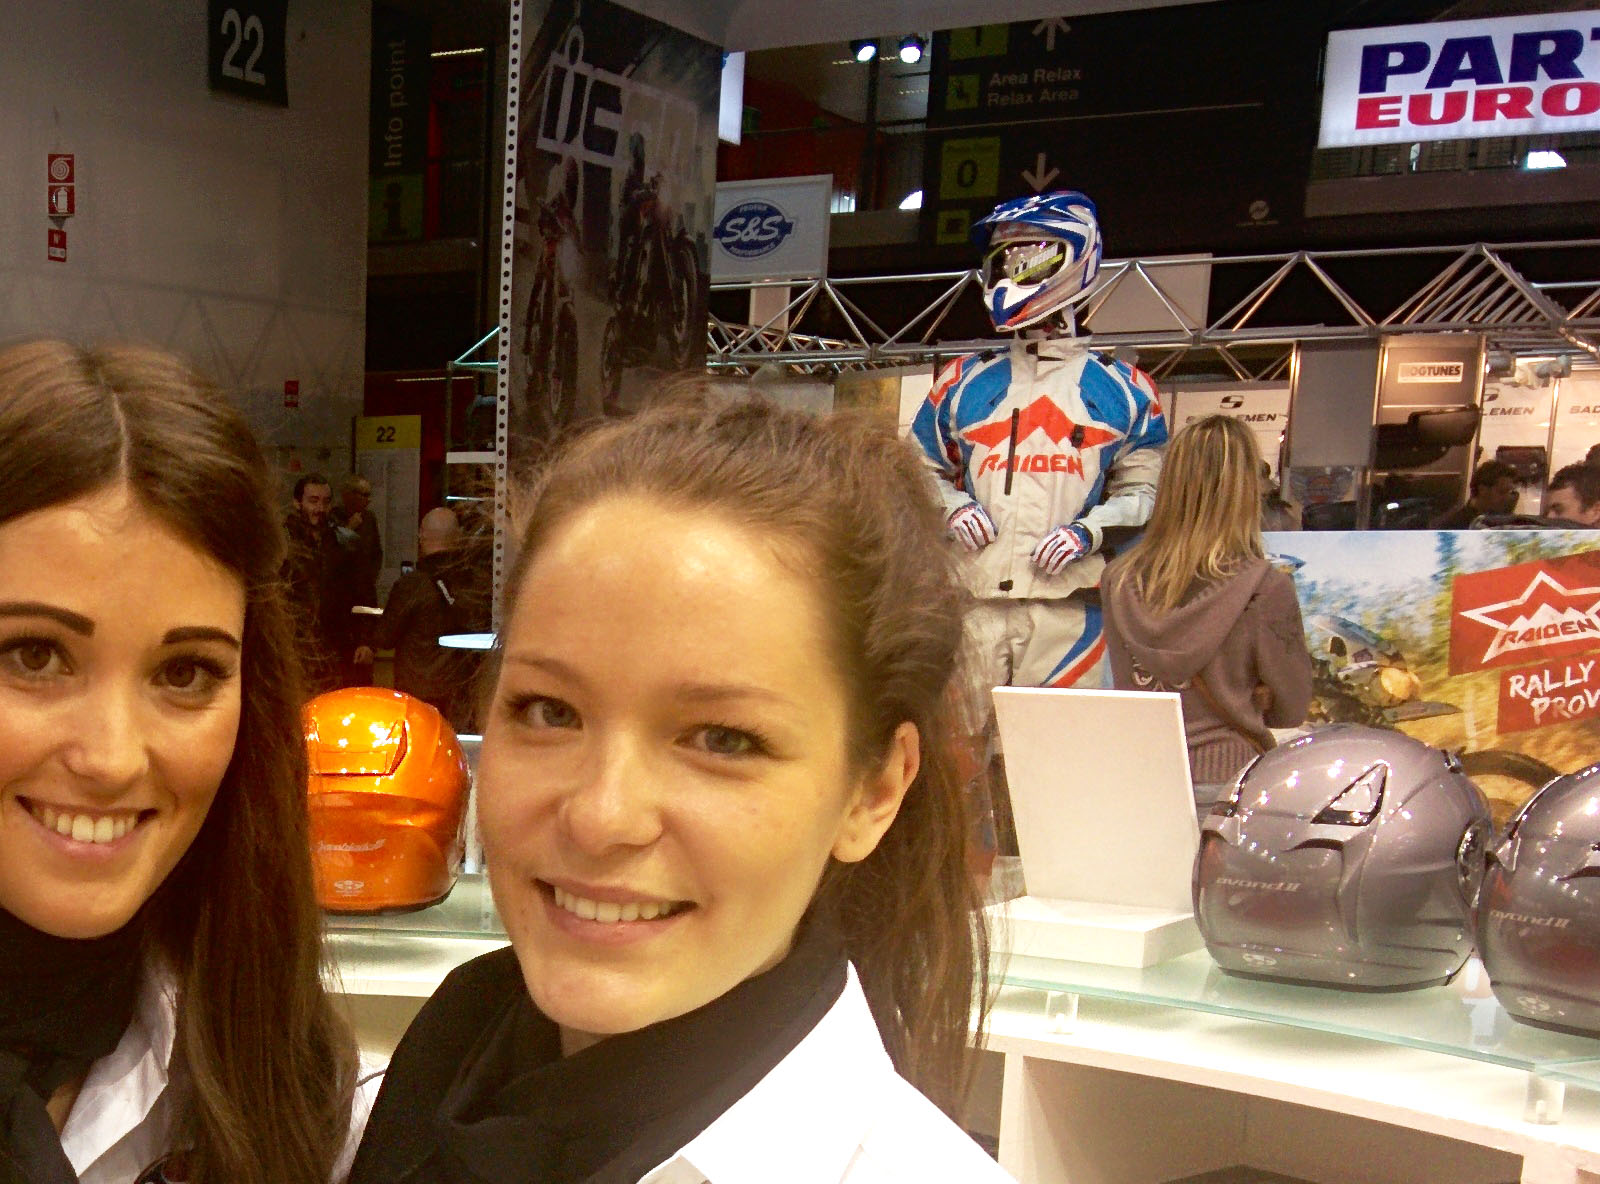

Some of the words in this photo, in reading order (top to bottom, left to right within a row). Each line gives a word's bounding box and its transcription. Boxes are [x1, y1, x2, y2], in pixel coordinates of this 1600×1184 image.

[221, 8, 266, 86] 22
[386, 40, 408, 108] point
[989, 71, 1029, 87] Area
[1033, 67, 1081, 83] Relax
[986, 92, 1033, 107] Relax
[1038, 88, 1079, 102] Area
[1355, 82, 1600, 130] EURO
[384, 117, 403, 167] Info
[720, 214, 784, 244] S&S
[375, 425, 397, 443] 22
[977, 452, 1086, 482] RAIDEN
[1497, 616, 1600, 650] RAIDEN
[1508, 659, 1596, 700] RALLY
